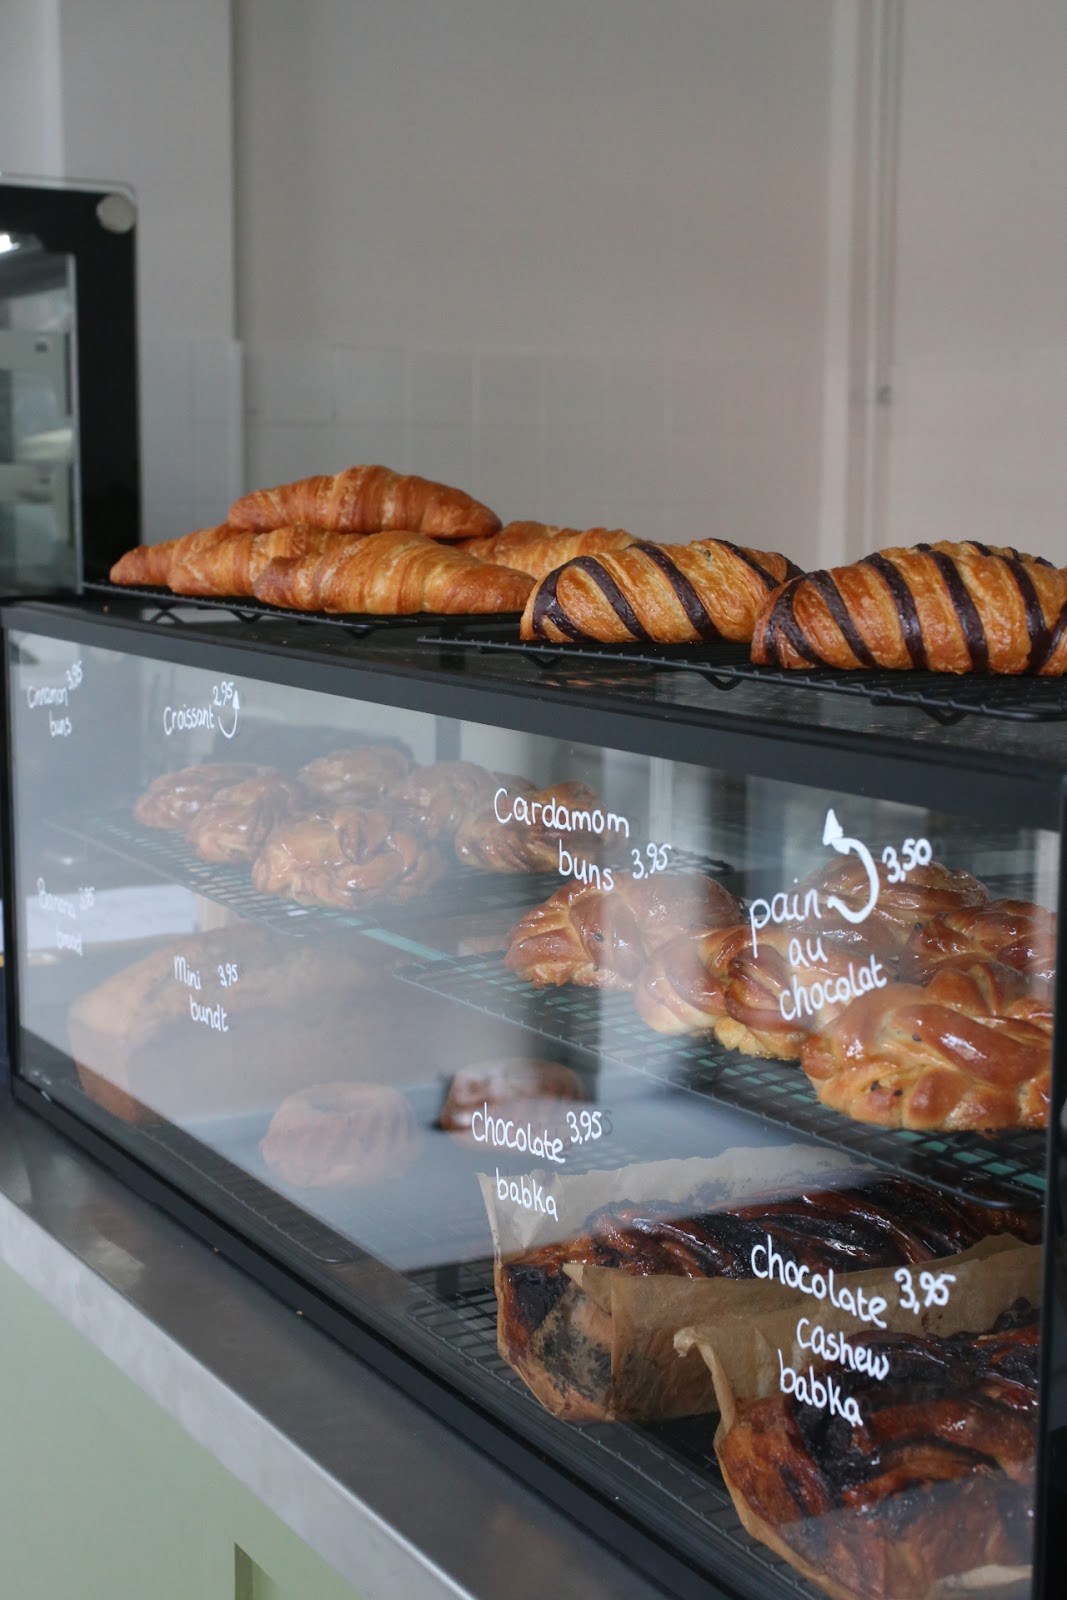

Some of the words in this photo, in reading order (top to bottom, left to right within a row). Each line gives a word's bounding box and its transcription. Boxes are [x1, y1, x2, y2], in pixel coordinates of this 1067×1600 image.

[164, 704, 215, 736] Croissant
[493, 787, 630, 838] Cardamom
[558, 838, 615, 891] buns
[750, 878, 822, 959] pain
[881, 838, 933, 884] 3,50
[174, 955, 202, 990] Mini
[788, 937, 828, 968] au
[779, 953, 888, 1021] chocolat
[189, 993, 229, 1032] bundt
[566, 1110, 603, 1145] 3,95
[495, 1167, 559, 1222] babka
[894, 1267, 957, 1315] 3,95
[777, 1348, 864, 1428] babka
